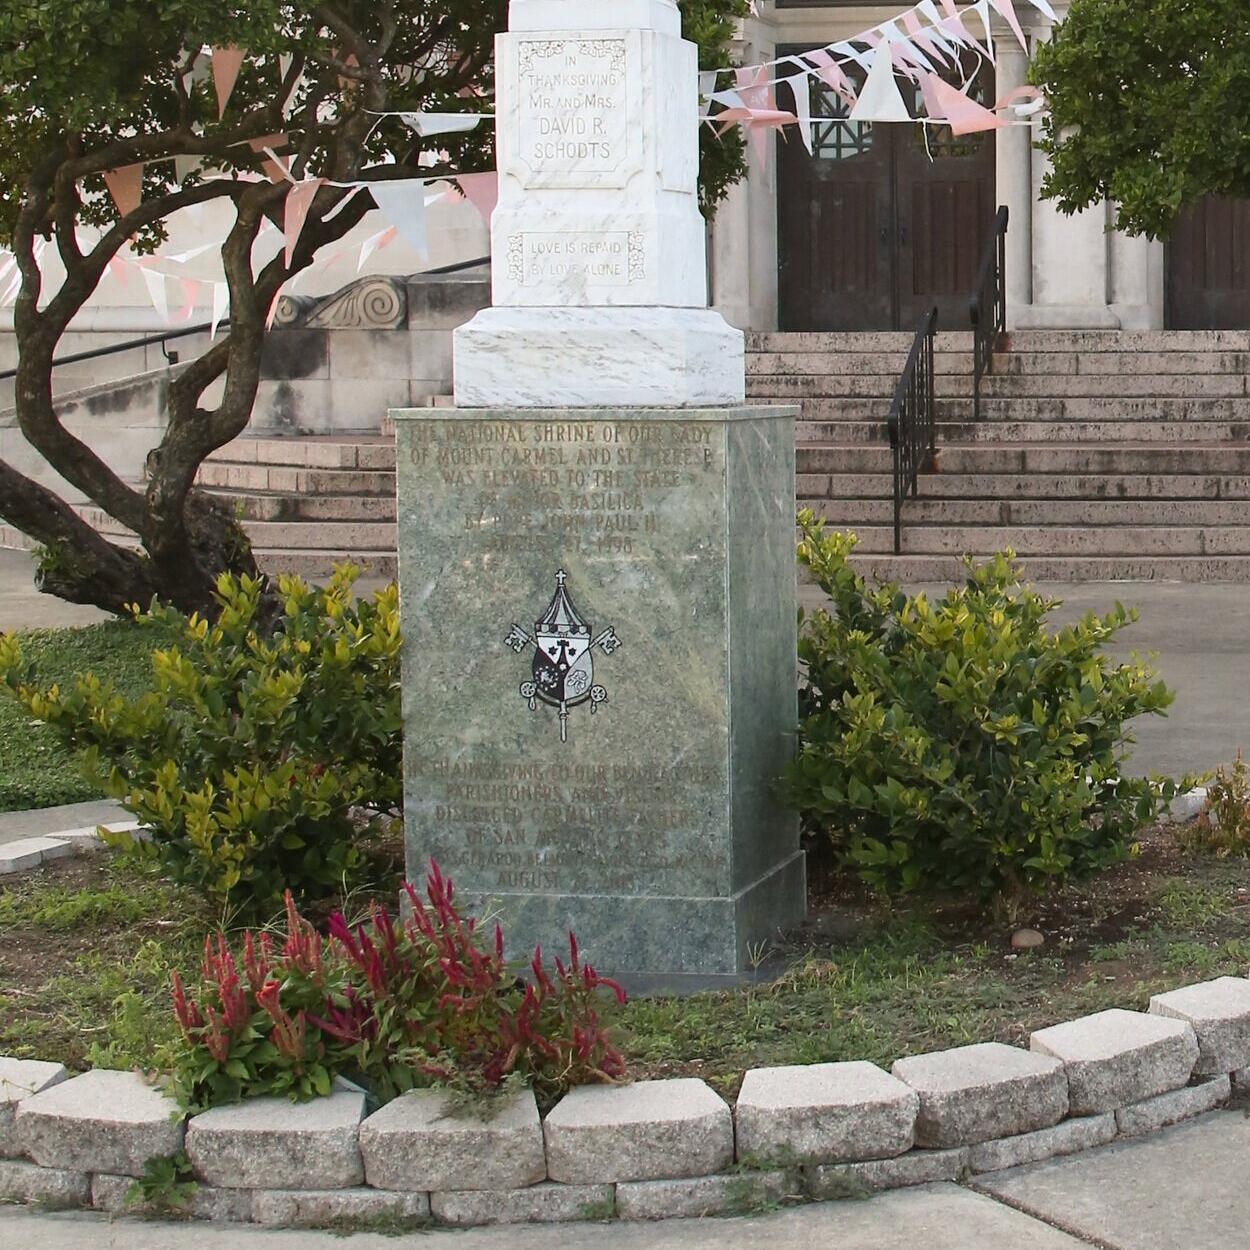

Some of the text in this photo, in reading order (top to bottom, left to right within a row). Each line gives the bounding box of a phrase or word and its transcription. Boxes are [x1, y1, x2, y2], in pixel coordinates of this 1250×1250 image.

[565, 55, 576, 66] IN
[528, 74, 616, 87] THANKSGIVING
[540, 117, 607, 135] DAVID R.
[531, 242, 621, 254] LOVE IS REPAID
[531, 264, 621, 276] BY LOVE ALONE
[446, 426, 526, 442] NATIONAL
[534, 426, 594, 443] SHRINE
[603, 426, 622, 443] OF
[629, 426, 663, 443] OUR
[411, 448, 430, 465] OF
[437, 449, 494, 465] MOUNT
[501, 448, 567, 465] CARMEL
[577, 449, 611, 465] AND
[443, 470, 475, 486] WAS
[483, 470, 559, 487] ELEVATED
[568, 470, 585, 487] TO
[594, 470, 624, 487] THE
[570, 493, 644, 510] BASILICA
[596, 514, 638, 531] PAUL
[496, 870, 561, 889] AUGUST
